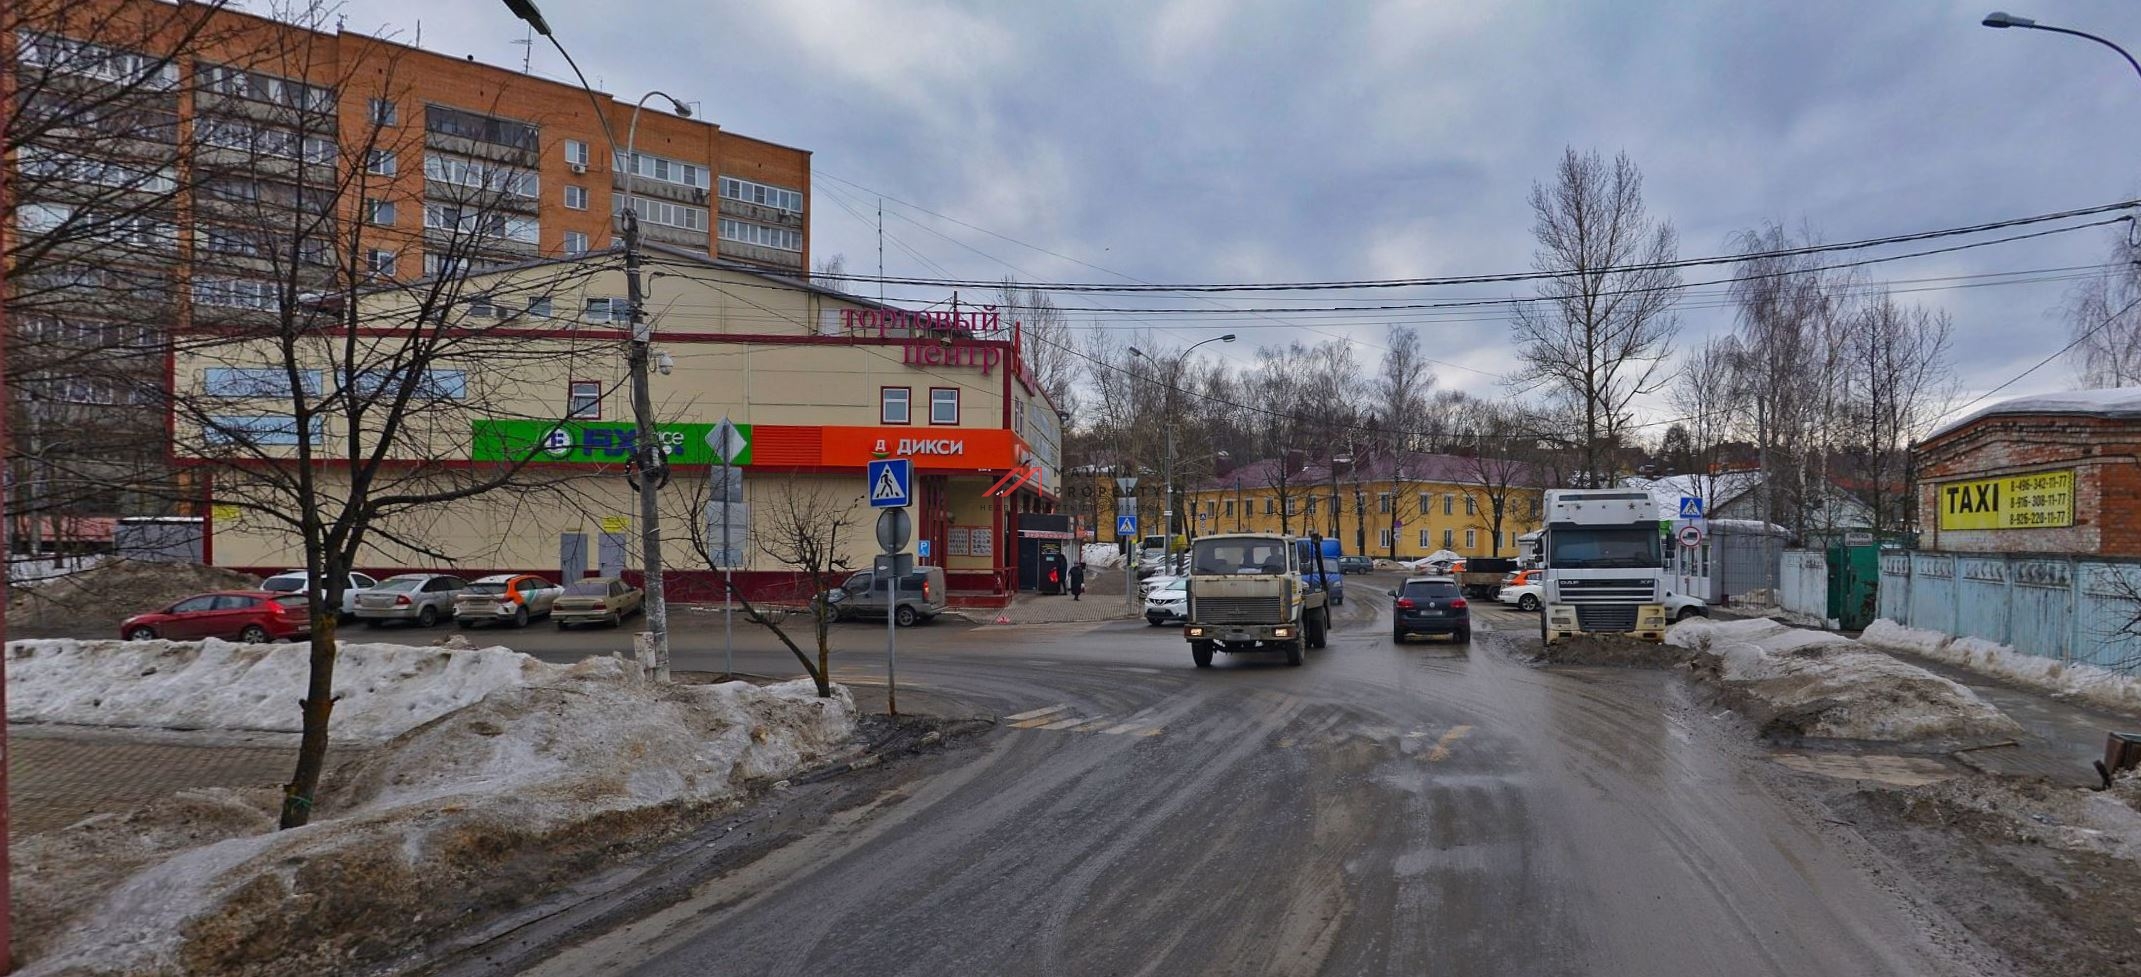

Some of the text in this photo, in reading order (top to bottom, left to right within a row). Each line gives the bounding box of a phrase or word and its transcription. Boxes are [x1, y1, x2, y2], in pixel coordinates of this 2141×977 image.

[840, 305, 1000, 337] торговый
[902, 343, 1000, 376] центр
[583, 428, 638, 456] FIX
[897, 439, 963, 455] ДИКСИ
[1947, 483, 1999, 514] TAXI
